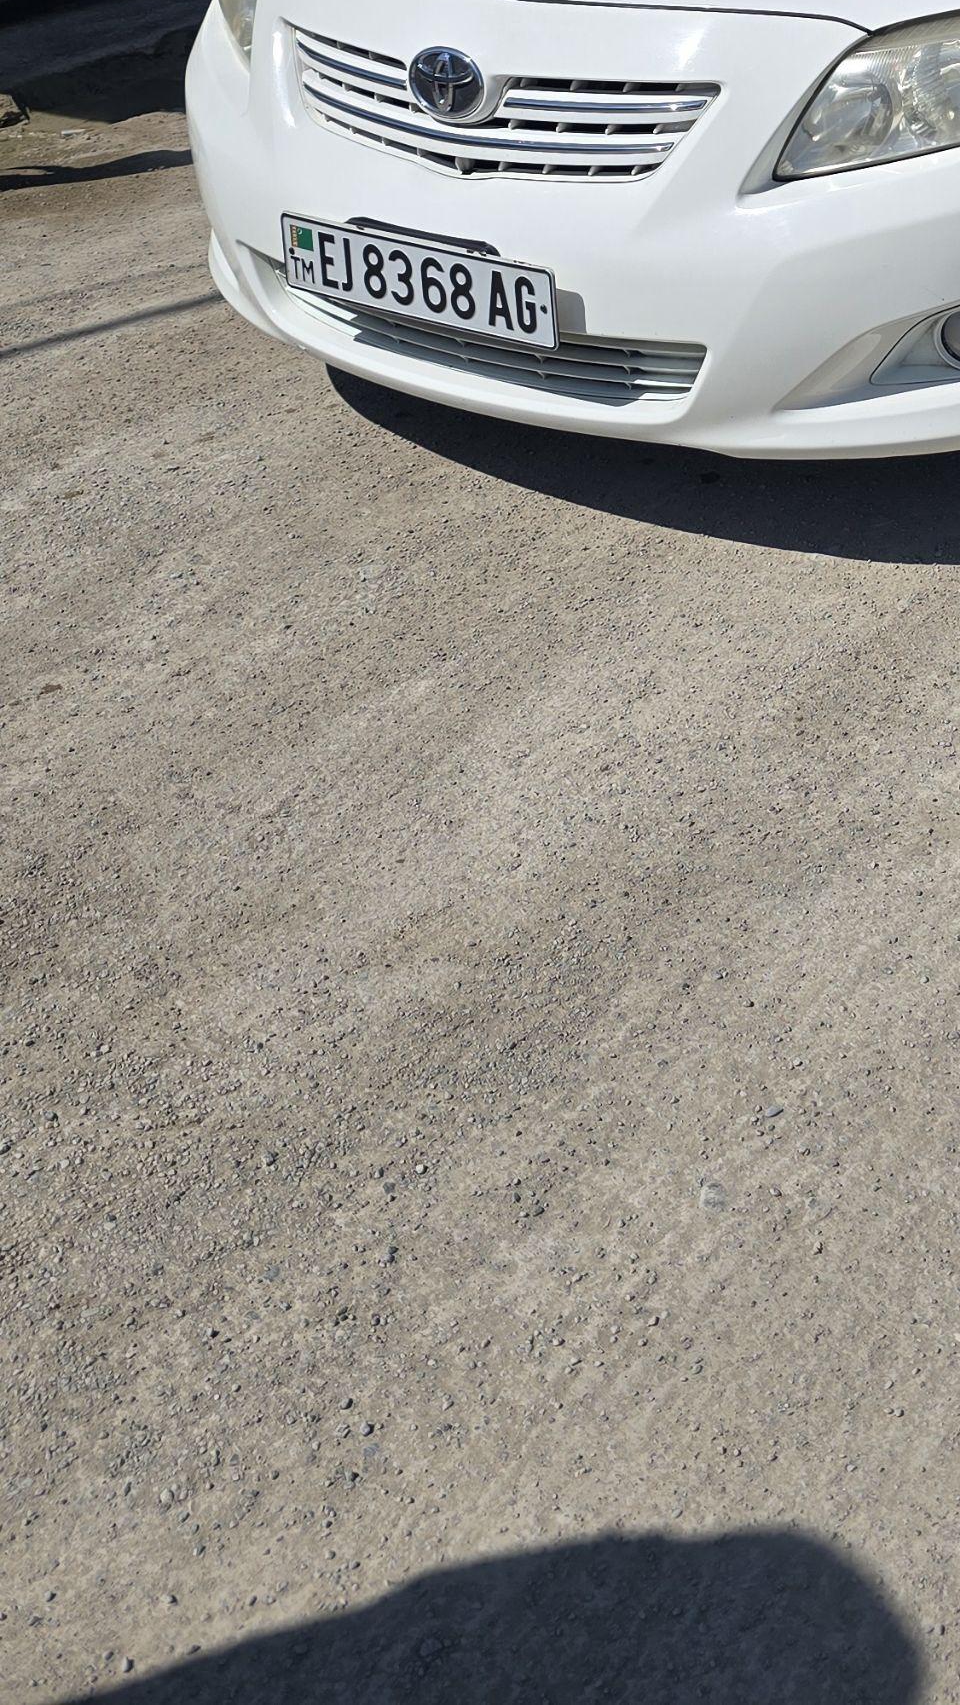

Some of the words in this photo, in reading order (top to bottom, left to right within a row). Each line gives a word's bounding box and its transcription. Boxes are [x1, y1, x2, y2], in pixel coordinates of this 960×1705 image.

[290, 254, 316, 285] TM
[317, 231, 354, 292] EJ
[362, 243, 476, 320] 8368
[488, 270, 538, 335] AG
